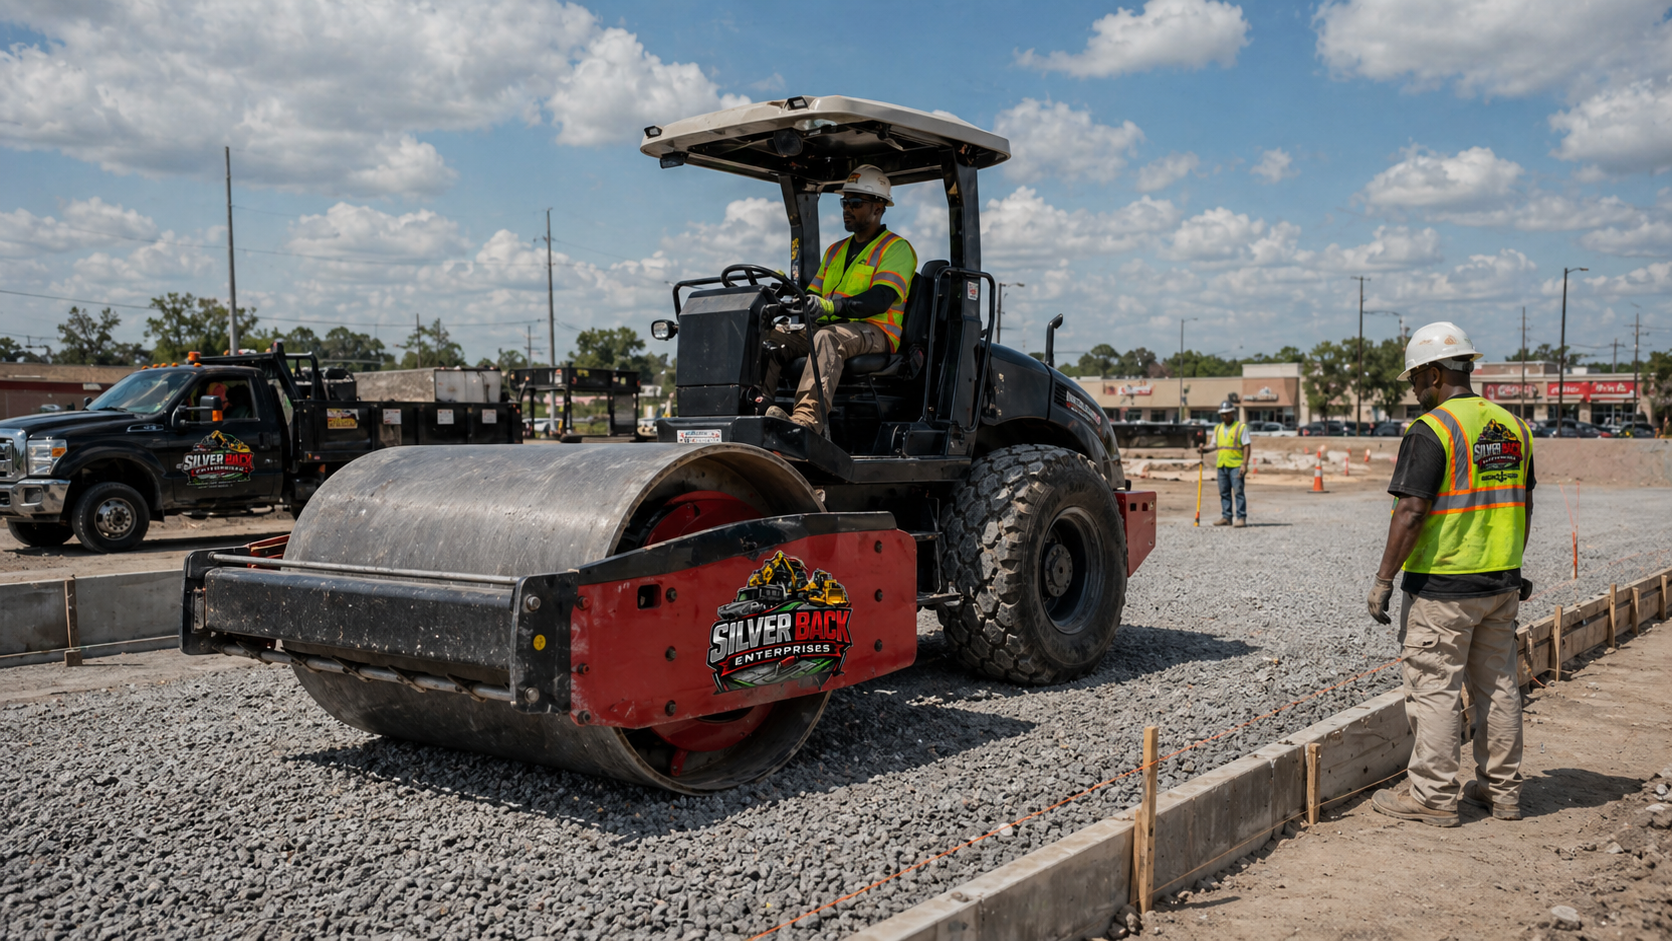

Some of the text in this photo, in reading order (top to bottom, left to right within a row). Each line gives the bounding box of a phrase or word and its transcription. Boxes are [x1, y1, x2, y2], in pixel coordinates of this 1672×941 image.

[183, 454, 223, 471] SILVER
[710, 610, 850, 663] SILVER BACK
[735, 644, 830, 666] ENTERPRISES
